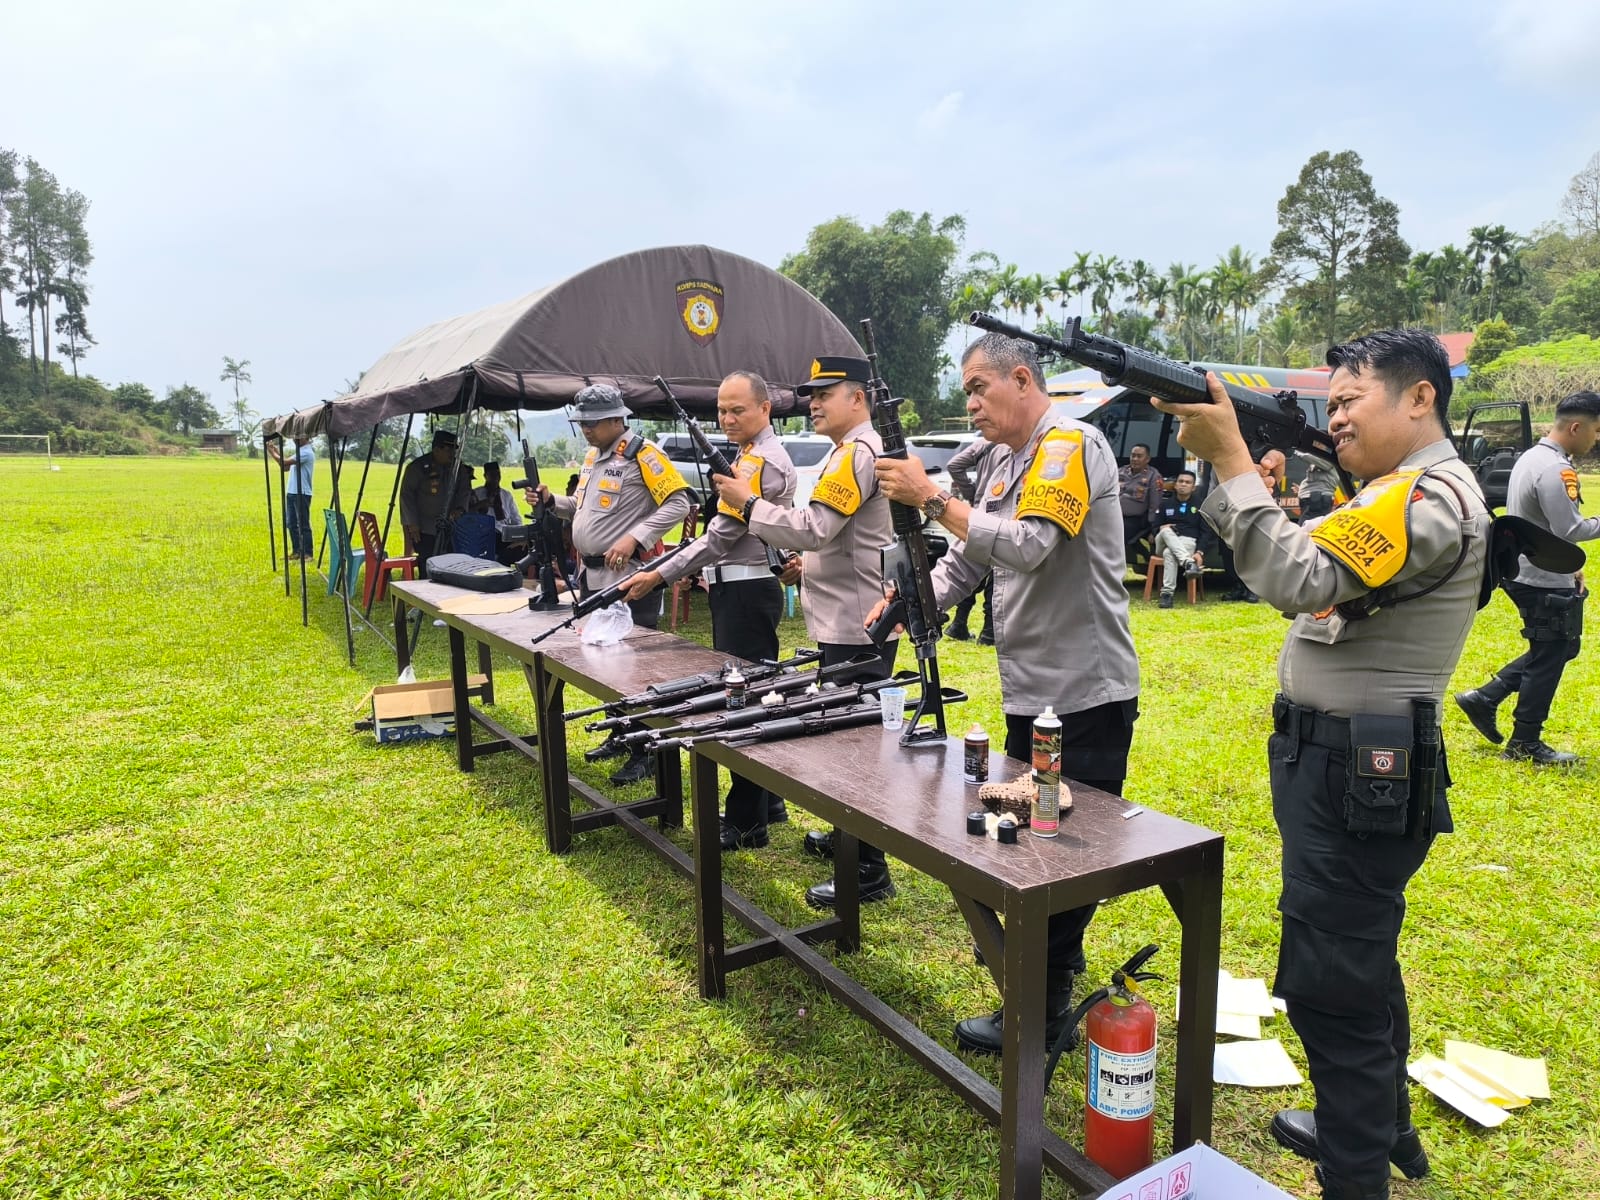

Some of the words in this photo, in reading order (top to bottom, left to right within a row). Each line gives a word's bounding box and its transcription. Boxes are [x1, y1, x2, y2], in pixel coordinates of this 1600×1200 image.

[604, 469, 623, 478] POLRI
[1101, 1052, 1118, 1061] FIRE
[1099, 1102, 1117, 1113] ABC
